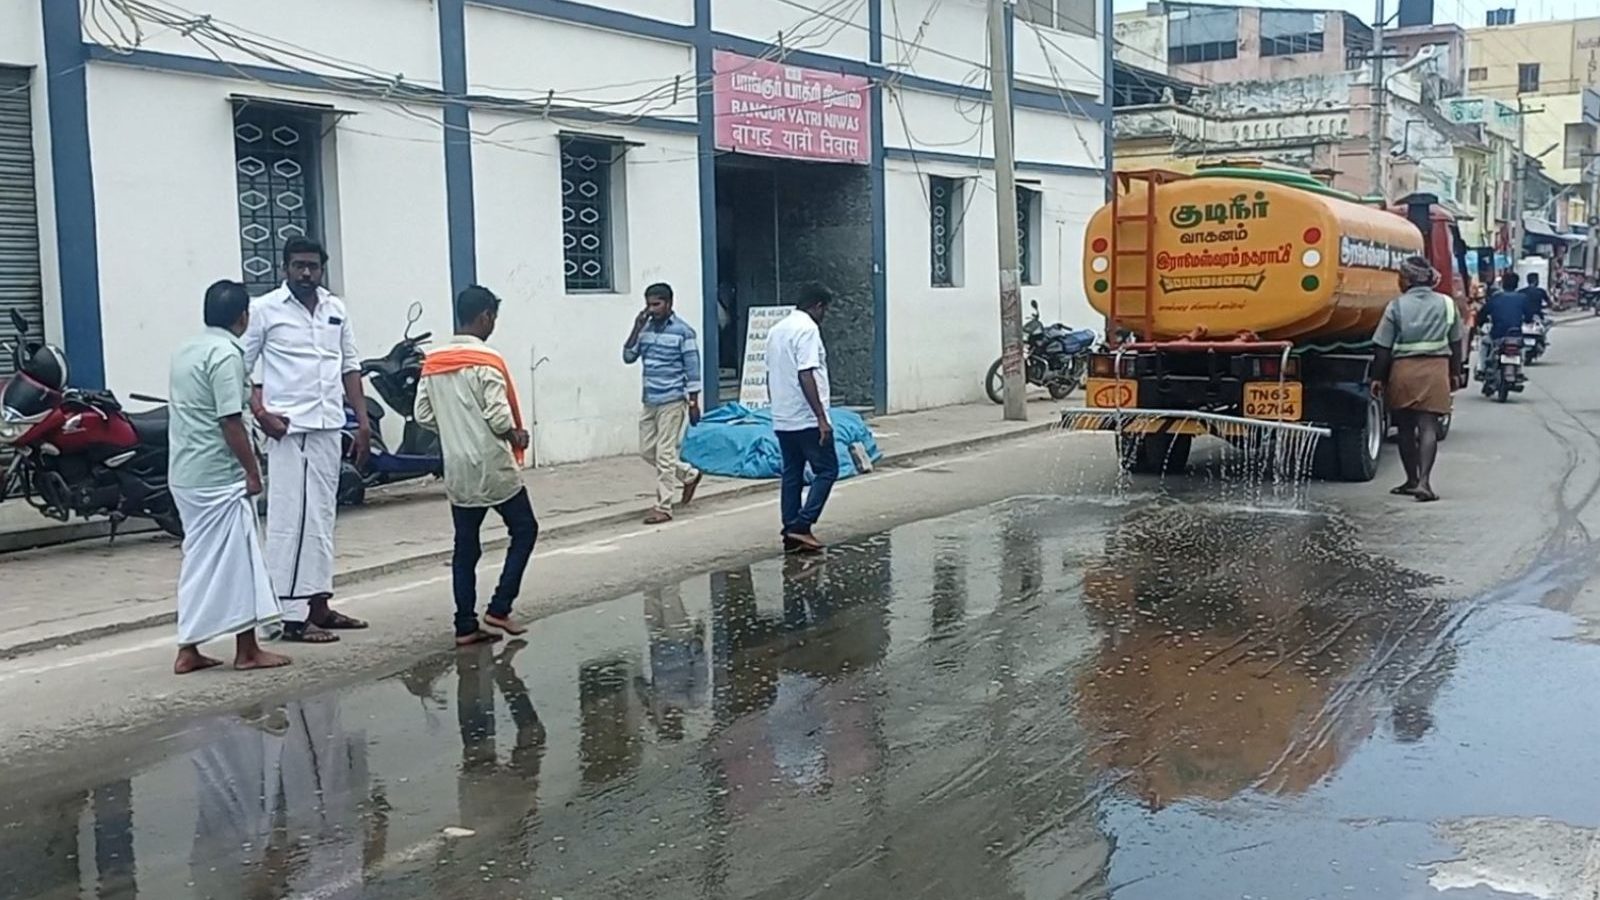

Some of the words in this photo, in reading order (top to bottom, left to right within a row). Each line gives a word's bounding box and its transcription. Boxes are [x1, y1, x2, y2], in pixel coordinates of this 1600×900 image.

[731, 99, 786, 122] BANGUR
[787, 107, 822, 127] YATRI
[823, 114, 859, 131] NIWAS
[781, 127, 813, 152] यात्री
[820, 130, 859, 156] निवास
[1169, 191, 1269, 229] குடிநீர்
[1179, 222, 1248, 244] வாகனம்
[1250, 389, 1269, 400] TN
[1271, 389, 1290, 400] 65
